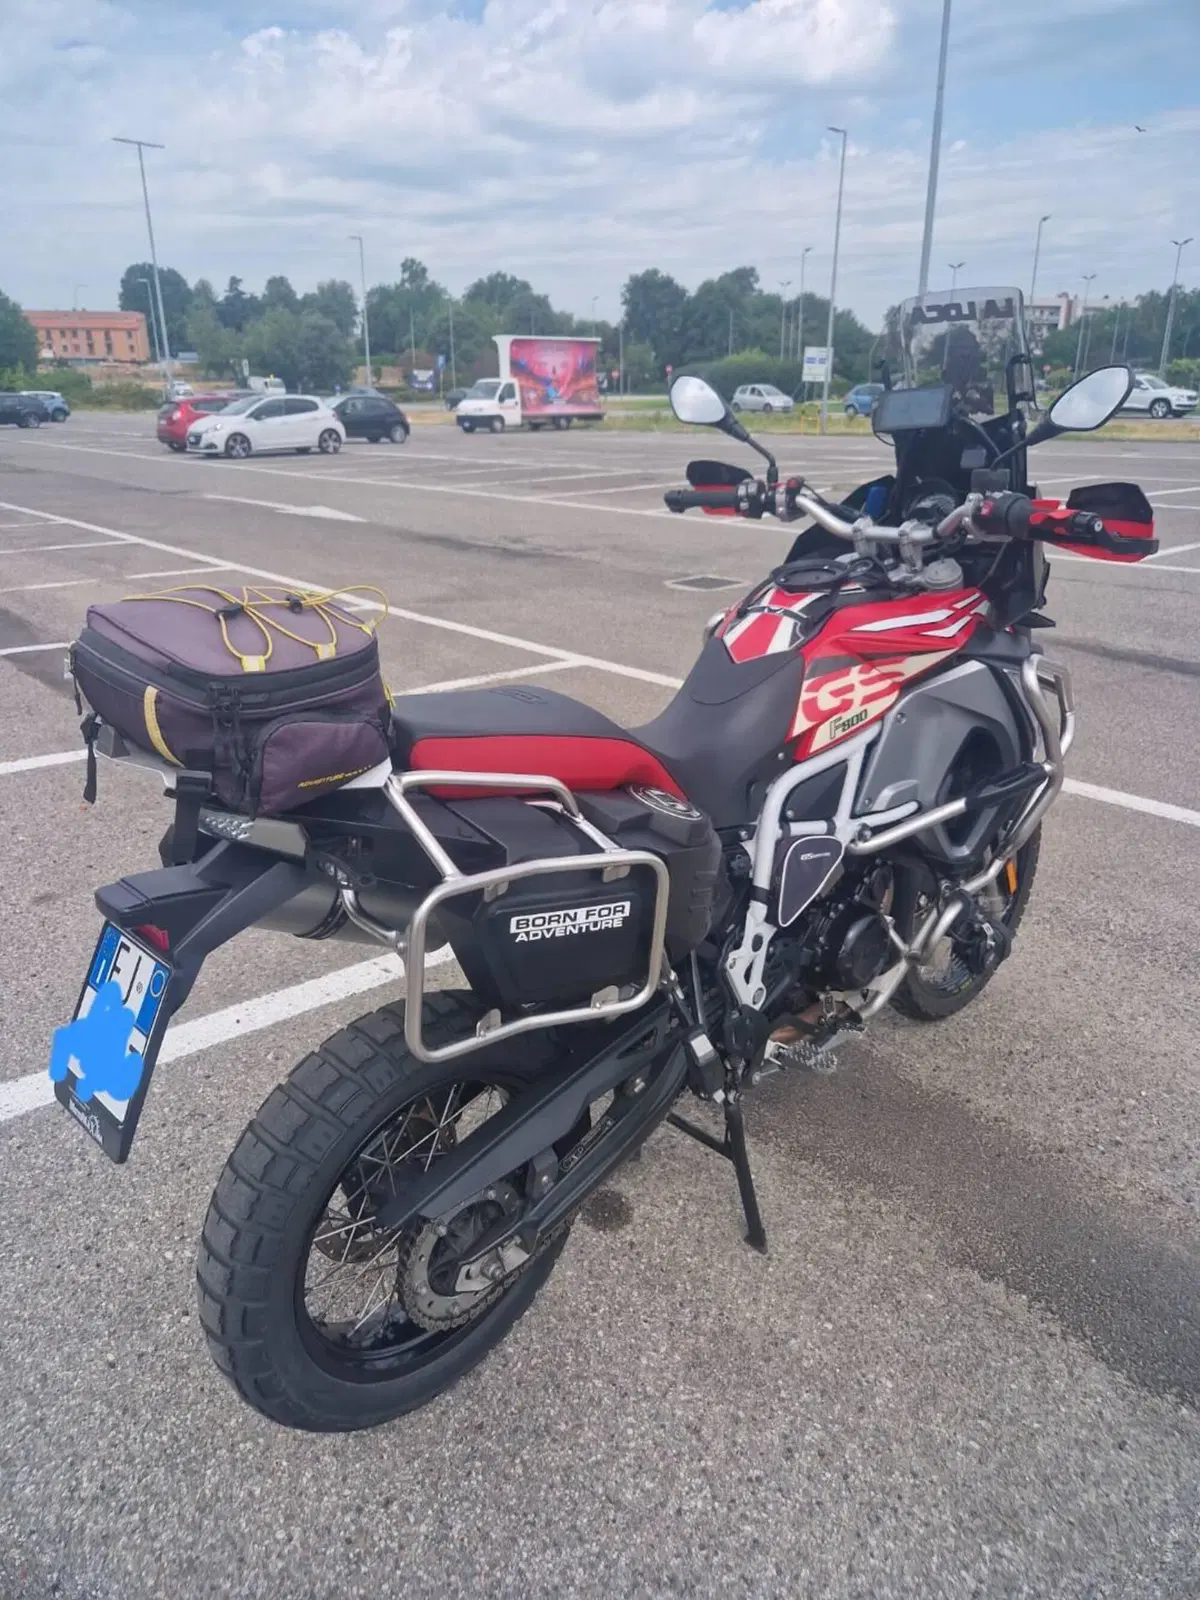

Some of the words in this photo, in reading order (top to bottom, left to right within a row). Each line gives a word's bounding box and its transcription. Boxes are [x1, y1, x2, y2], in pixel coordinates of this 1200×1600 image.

[515, 911, 578, 931] BORN
[585, 904, 627, 921] FOR
[515, 917, 624, 943] ADVENTURE
